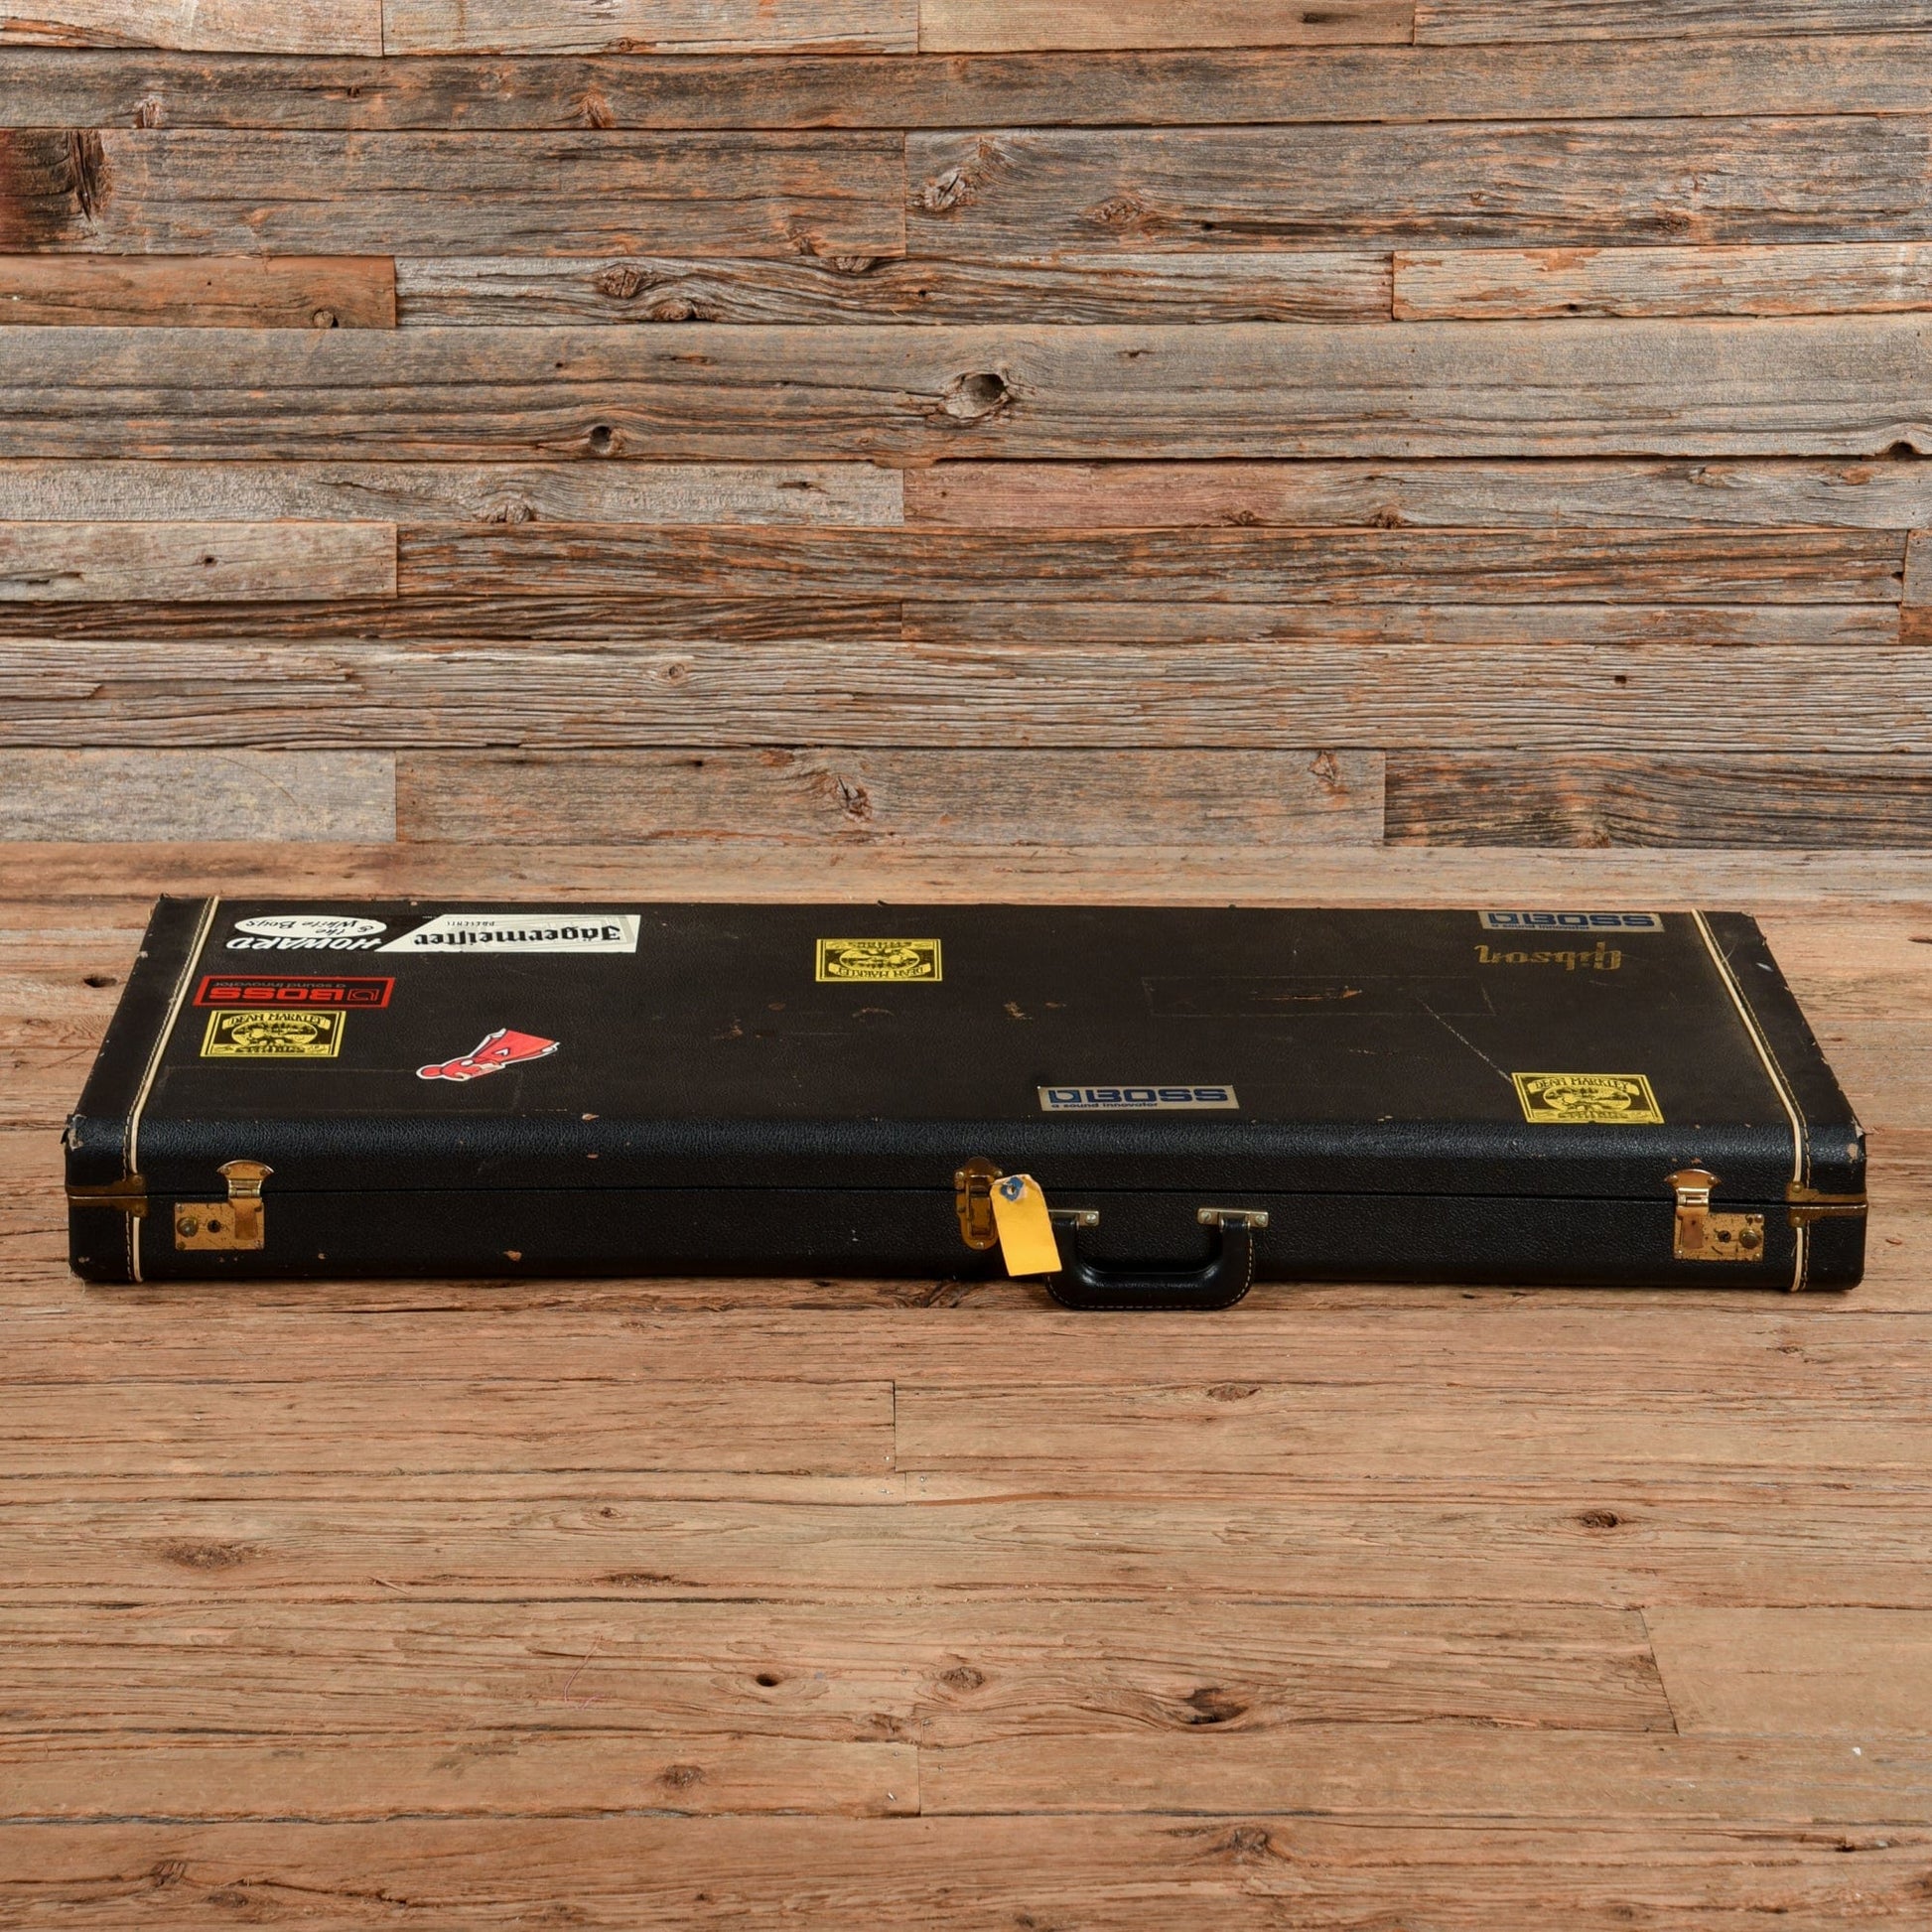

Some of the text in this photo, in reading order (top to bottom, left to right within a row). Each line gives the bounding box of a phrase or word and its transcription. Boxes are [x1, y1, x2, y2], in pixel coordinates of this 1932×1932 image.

[245, 920, 296, 929] Boys
[1522, 913, 1655, 926] BOSS
[225, 937, 382, 950] HOWARD
[1474, 941, 1622, 971] Gibson
[838, 966, 923, 978] DEAN MARKLEY
[208, 988, 345, 1001] BOSS
[230, 1014, 323, 1026] DEAN MARKLEY
[1535, 1077, 1629, 1090] DEAN MARKLEY
[1086, 1088, 1228, 1102] BOSS
